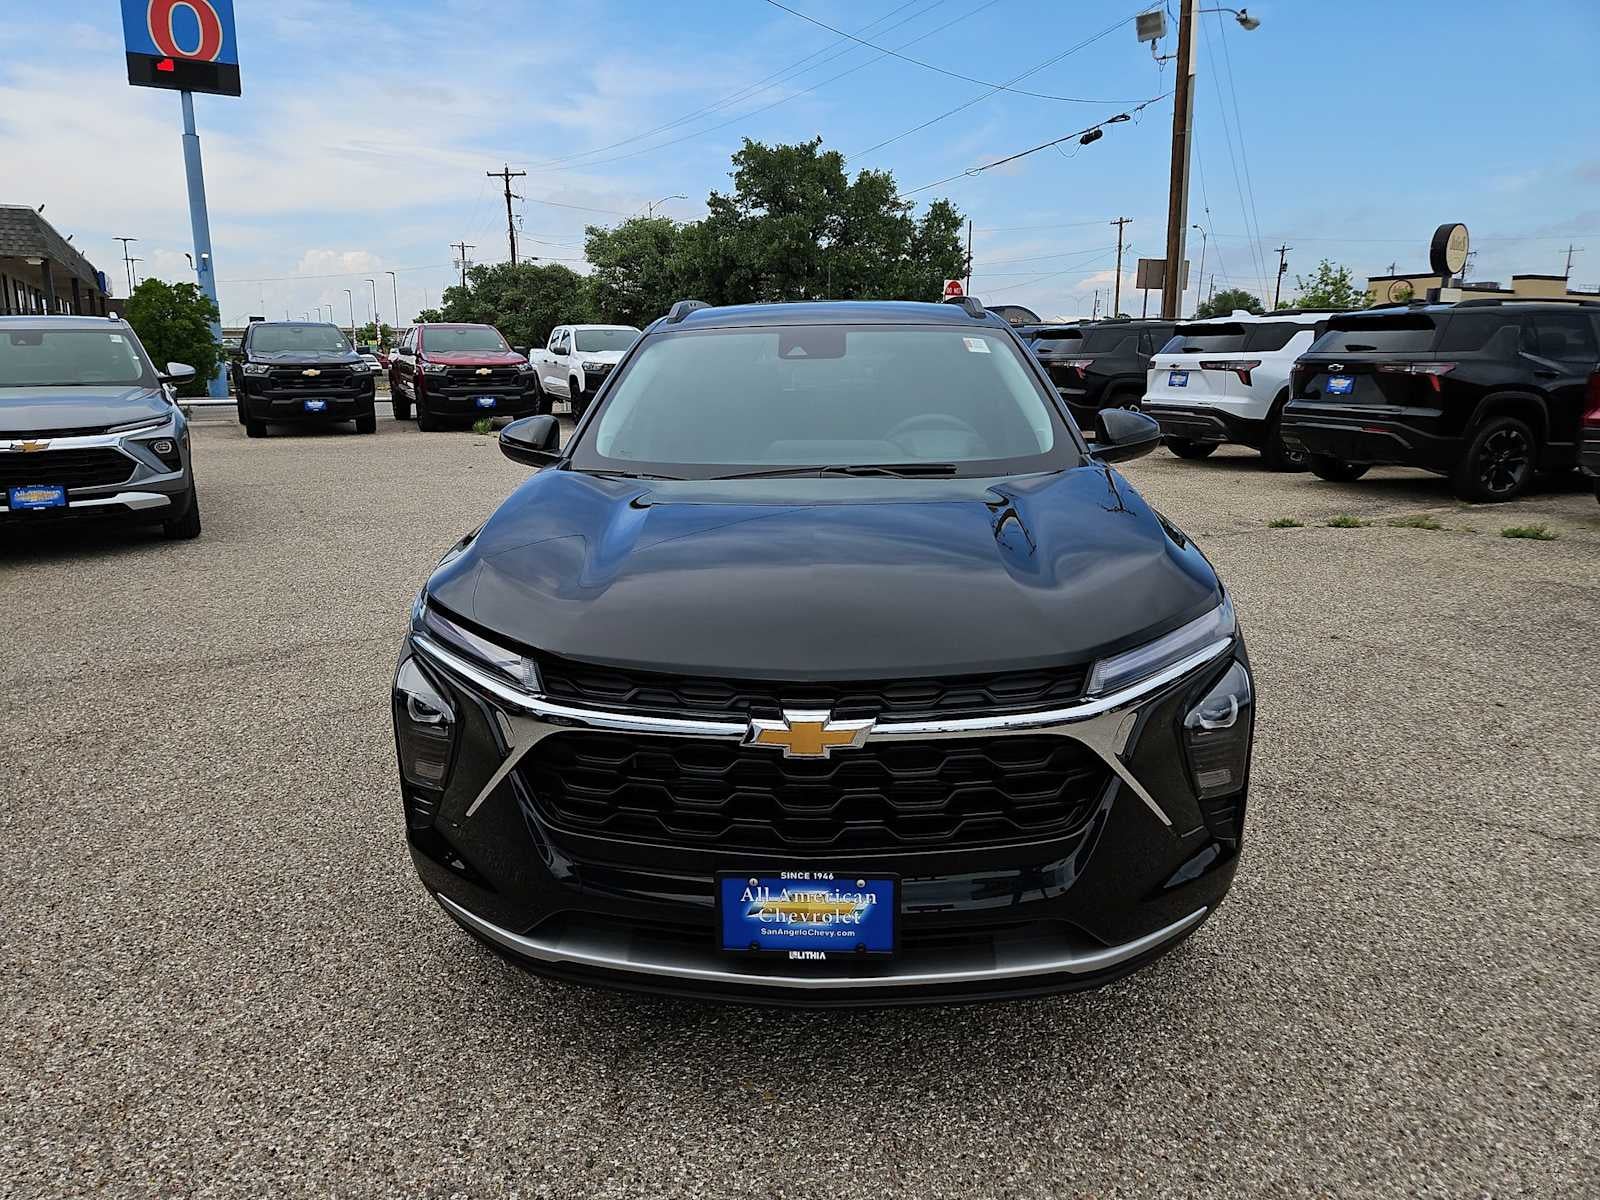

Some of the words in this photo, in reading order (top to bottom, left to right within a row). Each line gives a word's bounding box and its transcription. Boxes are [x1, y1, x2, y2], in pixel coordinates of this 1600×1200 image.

[780, 871, 810, 880] SINCE
[812, 872, 834, 880] 1946
[740, 886, 769, 903] All
[780, 888, 878, 905] American
[758, 908, 862, 925] Chevrolet
[760, 927, 856, 938] SanAngeloChevy.com
